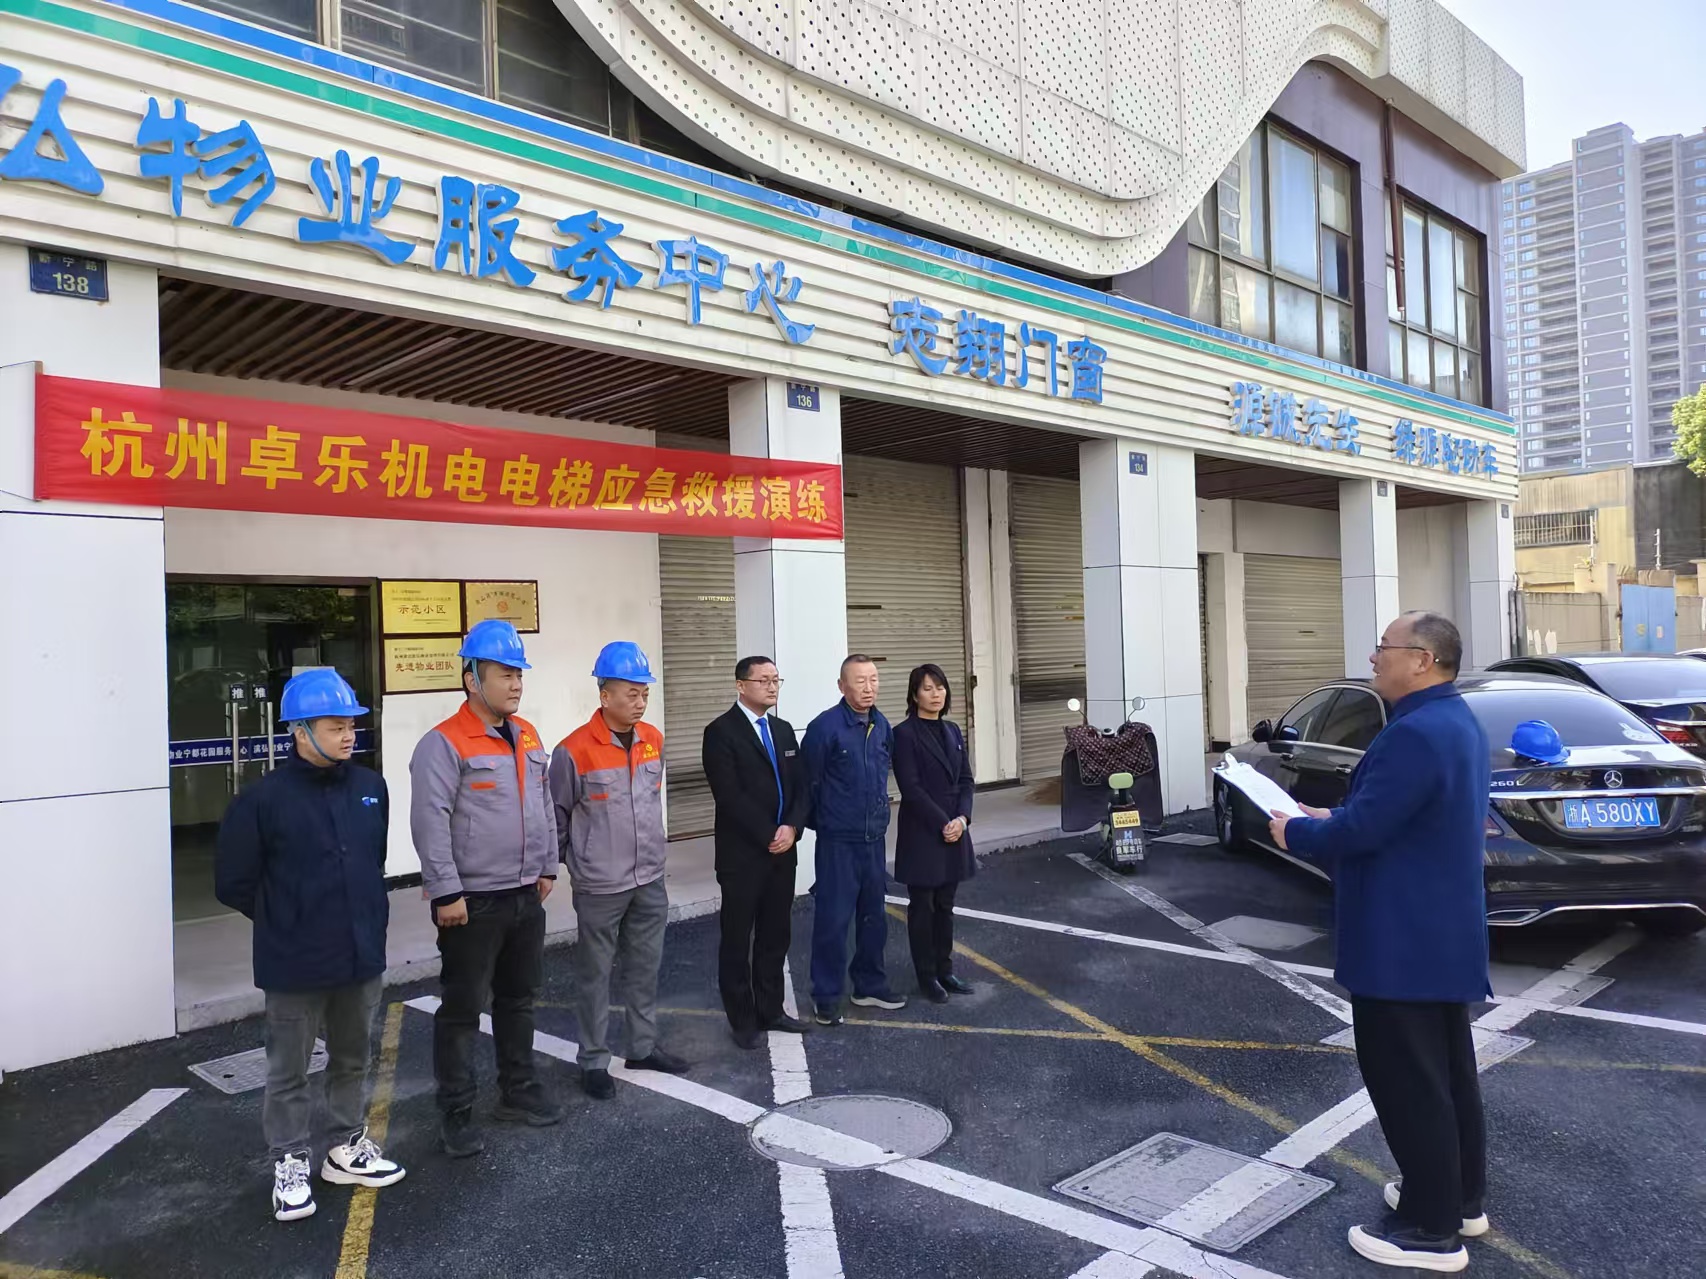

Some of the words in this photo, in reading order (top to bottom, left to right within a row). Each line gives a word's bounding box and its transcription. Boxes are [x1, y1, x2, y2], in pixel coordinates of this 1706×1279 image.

[52, 272, 89, 294] 138
[796, 394, 812, 408] 136
[79, 406, 828, 525] 杭州卓乐机电电梯应急救援演练
[231, 687, 245, 699] 推
[254, 687, 267, 699] 推
